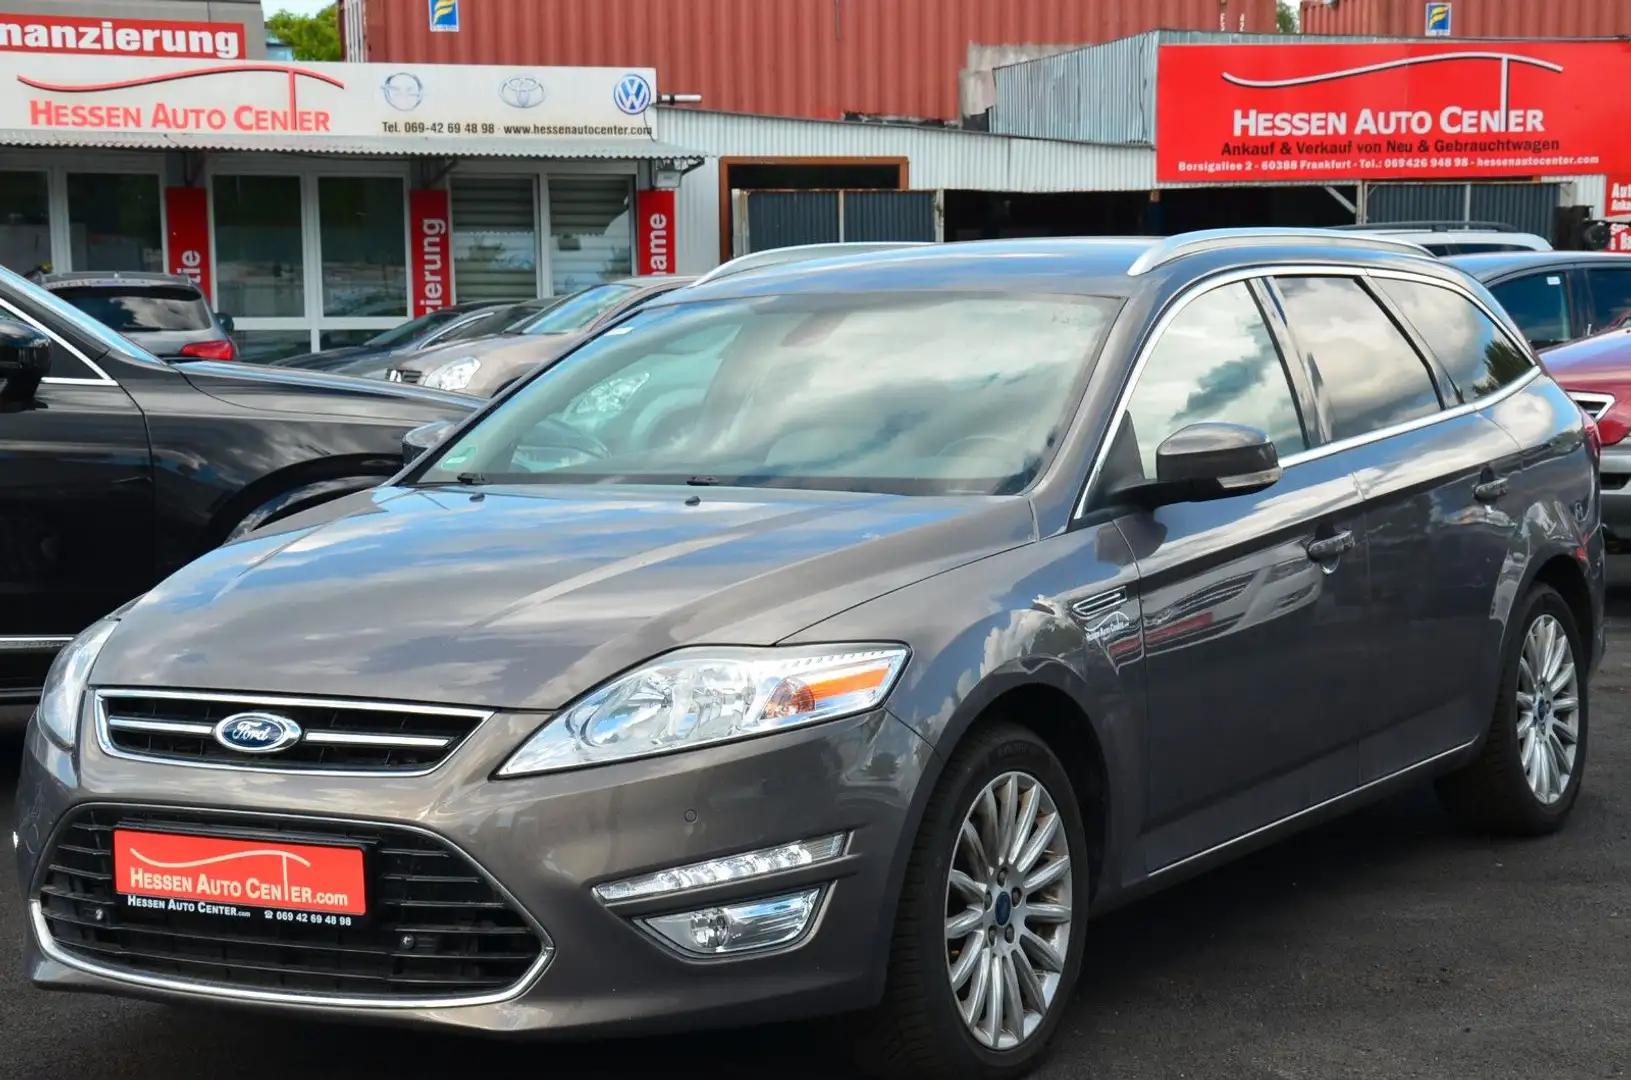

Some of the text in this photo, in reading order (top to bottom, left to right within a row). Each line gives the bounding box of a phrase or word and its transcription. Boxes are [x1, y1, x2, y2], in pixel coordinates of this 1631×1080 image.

[0, 21, 240, 59] nanzierung
[30, 100, 142, 128] HESSEN
[151, 102, 227, 130] AUTO
[1233, 109, 1347, 137] HESSEN
[1354, 108, 1433, 135] AUTO
[382, 121, 401, 133] Tel.
[404, 121, 444, 133] 069-42
[447, 122, 461, 134] 69
[464, 122, 478, 134] 48
[481, 123, 495, 134] 98
[1220, 137, 1560, 157] Ankauf & Verkauf von Neu & Gebrauchtwagen
[1244, 160, 1252, 171] 2
[1299, 159, 1352, 170] Frankfurt
[231, 720, 272, 741] Ford
[130, 867, 193, 893] HESSEN
[196, 873, 242, 897] AUTO
[127, 895, 166, 909] HESSEN
[168, 898, 195, 912] AUTO
[276, 911, 352, 926] 069 42 69 48 98
